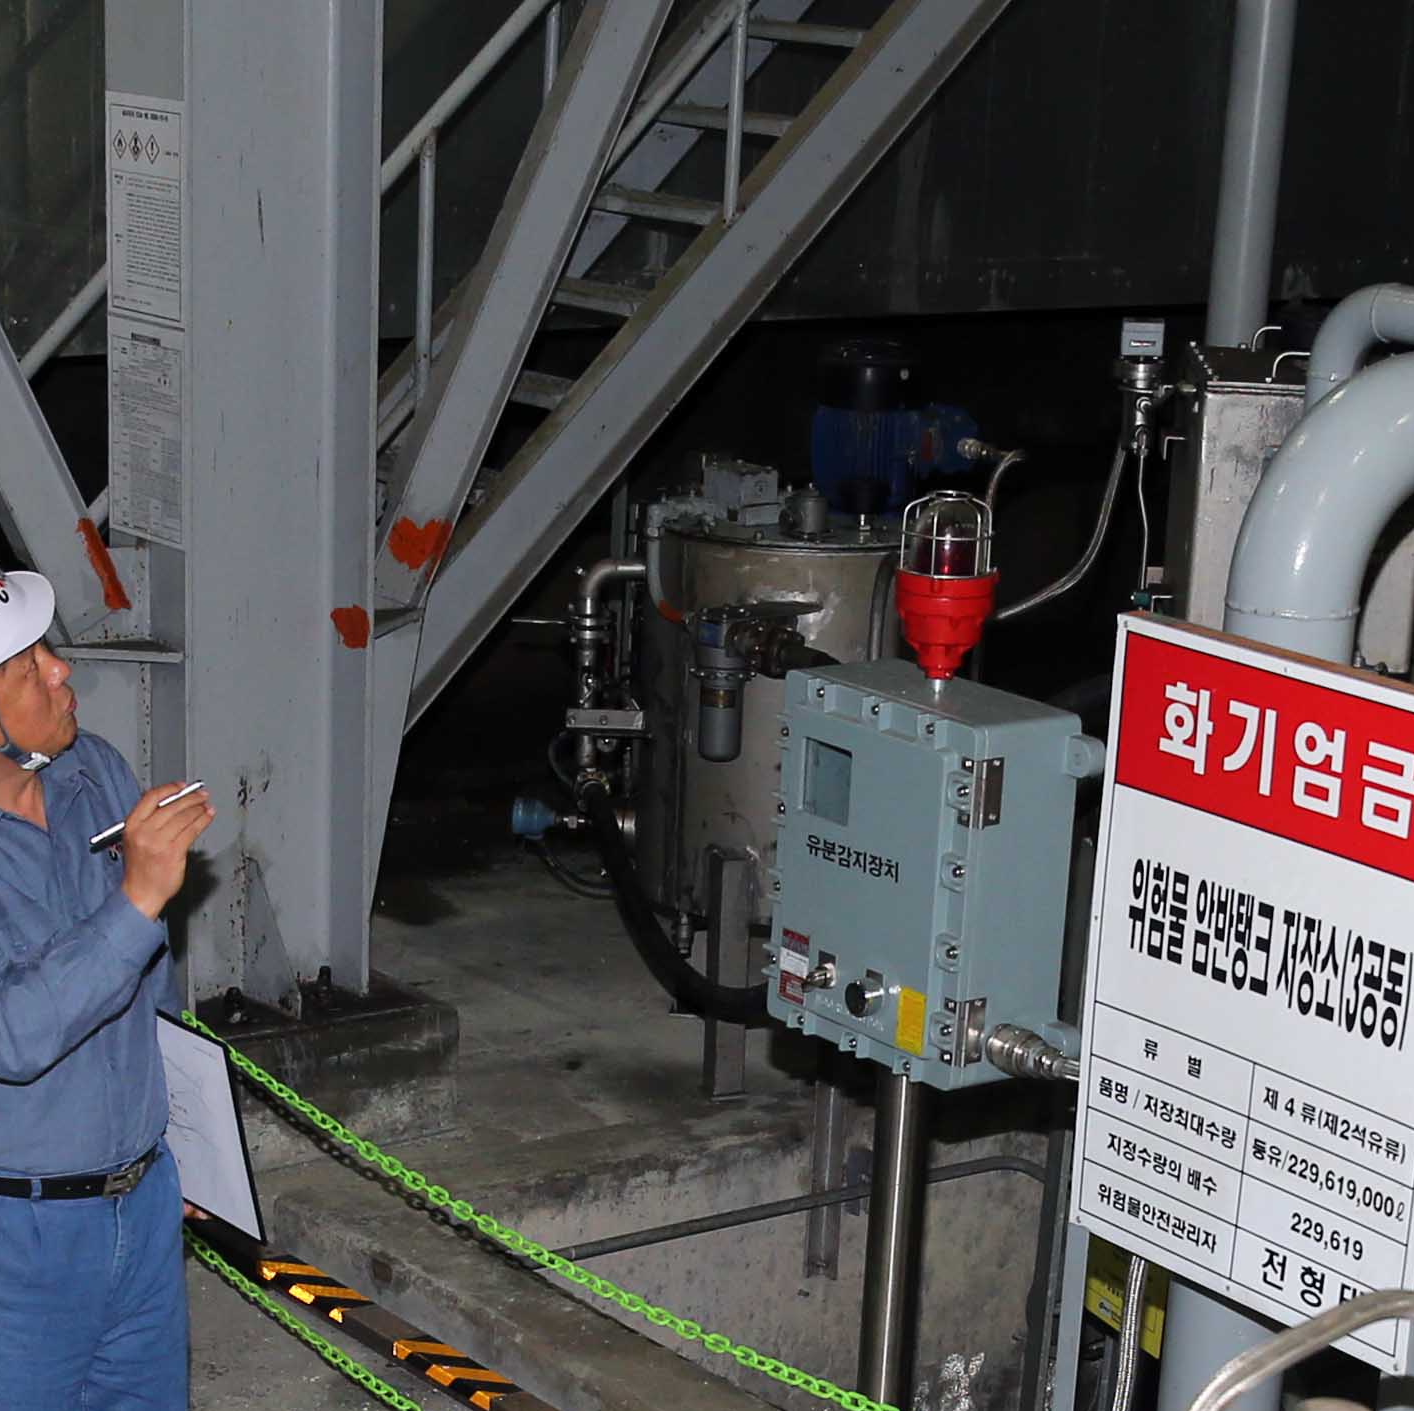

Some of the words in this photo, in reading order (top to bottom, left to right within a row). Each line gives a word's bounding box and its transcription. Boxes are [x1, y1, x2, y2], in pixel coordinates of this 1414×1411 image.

[806, 834, 900, 883] 유분감지장치
[1128, 858, 1189, 965] 위험물
[1192, 879, 1275, 996] 암반탱크
[1275, 910, 1414, 1052] 저장소(3공동)
[1143, 1038, 1158, 1061] 류
[1187, 1055, 1202, 1079] 별
[1098, 1076, 1129, 1104] 품명
[1143, 1093, 1237, 1150] 저장최대수량
[1263, 1086, 1279, 1111] 제
[1284, 1098, 1295, 1117] 4
[1301, 1102, 1406, 1165] 류(제2석유류)
[1107, 1133, 1183, 1183] 지정수량의
[1187, 1167, 1218, 1197] 배수
[1097, 1183, 1217, 1254] 위험물안전관리자
[1290, 1212, 1364, 1261] 229,619
[1262, 1248, 1287, 1291] 전
[1300, 1265, 1326, 1308] 형
